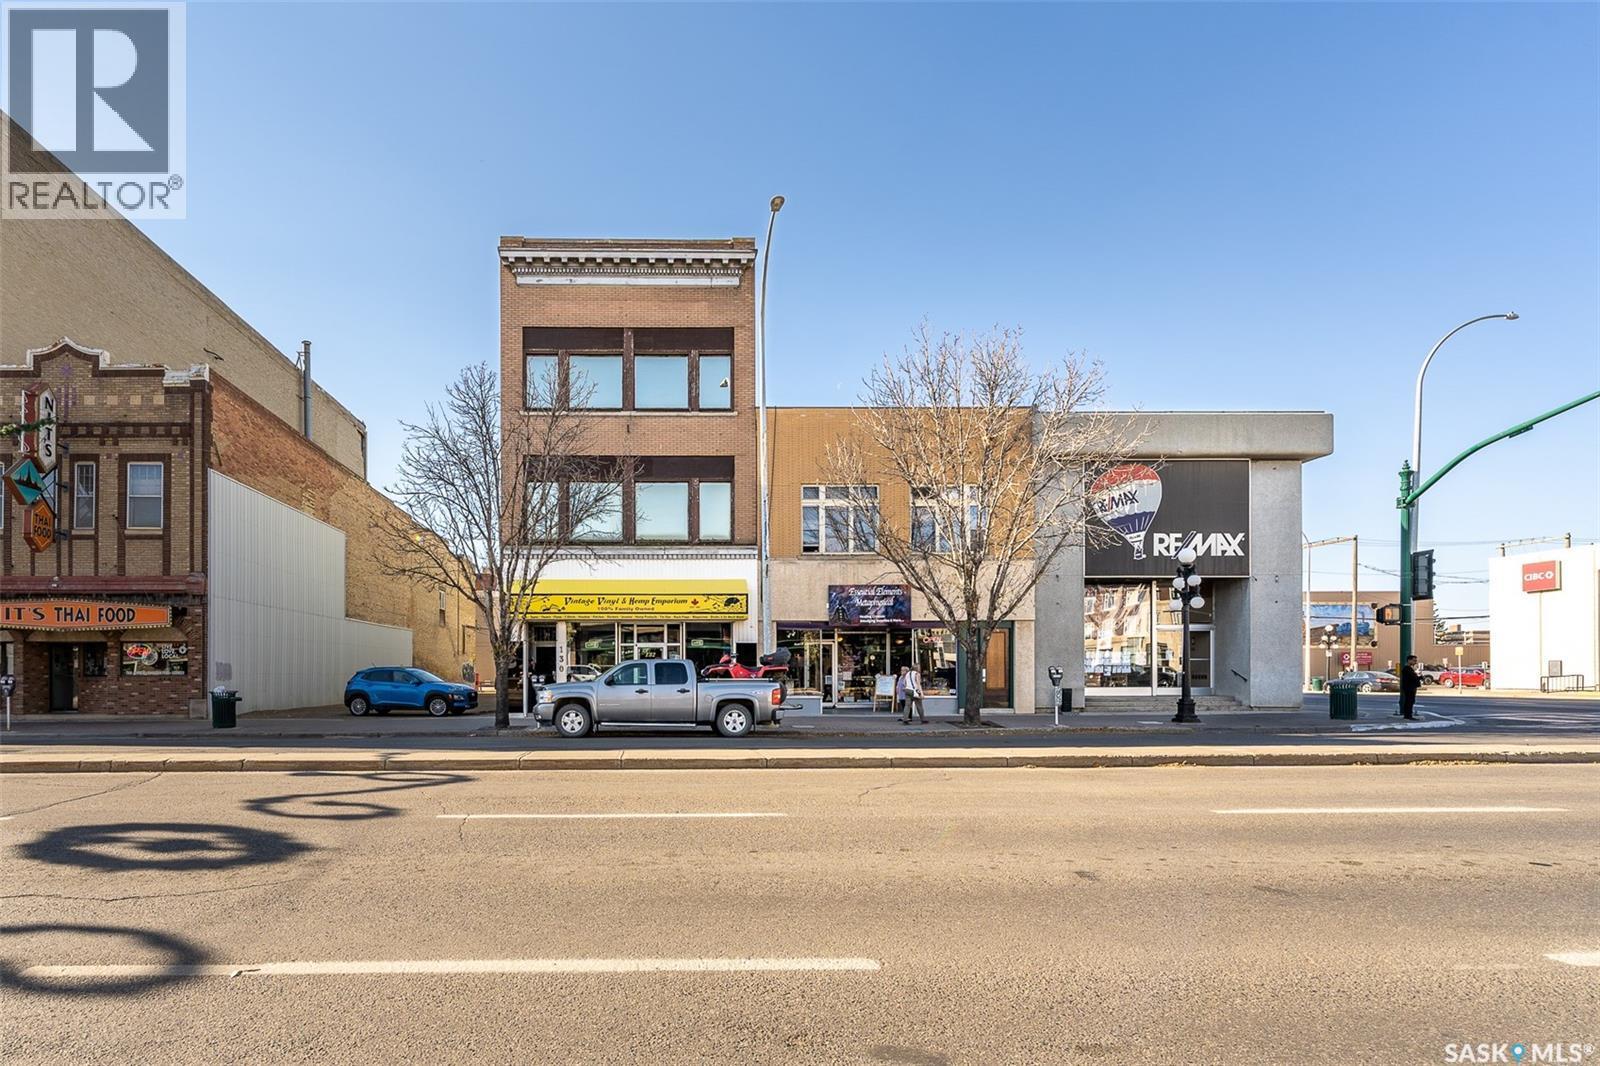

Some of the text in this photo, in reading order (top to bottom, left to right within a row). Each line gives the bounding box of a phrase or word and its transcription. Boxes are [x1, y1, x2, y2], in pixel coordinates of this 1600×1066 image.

[1153, 531, 1246, 559] RE/MAX
[564, 597, 595, 606] Vintage
[597, 597, 620, 606] Vinyl
[629, 597, 650, 606] Hemp
[651, 597, 688, 606] Emporium
[54, 606, 90, 622] THAI
[98, 606, 136, 622] FOOD
